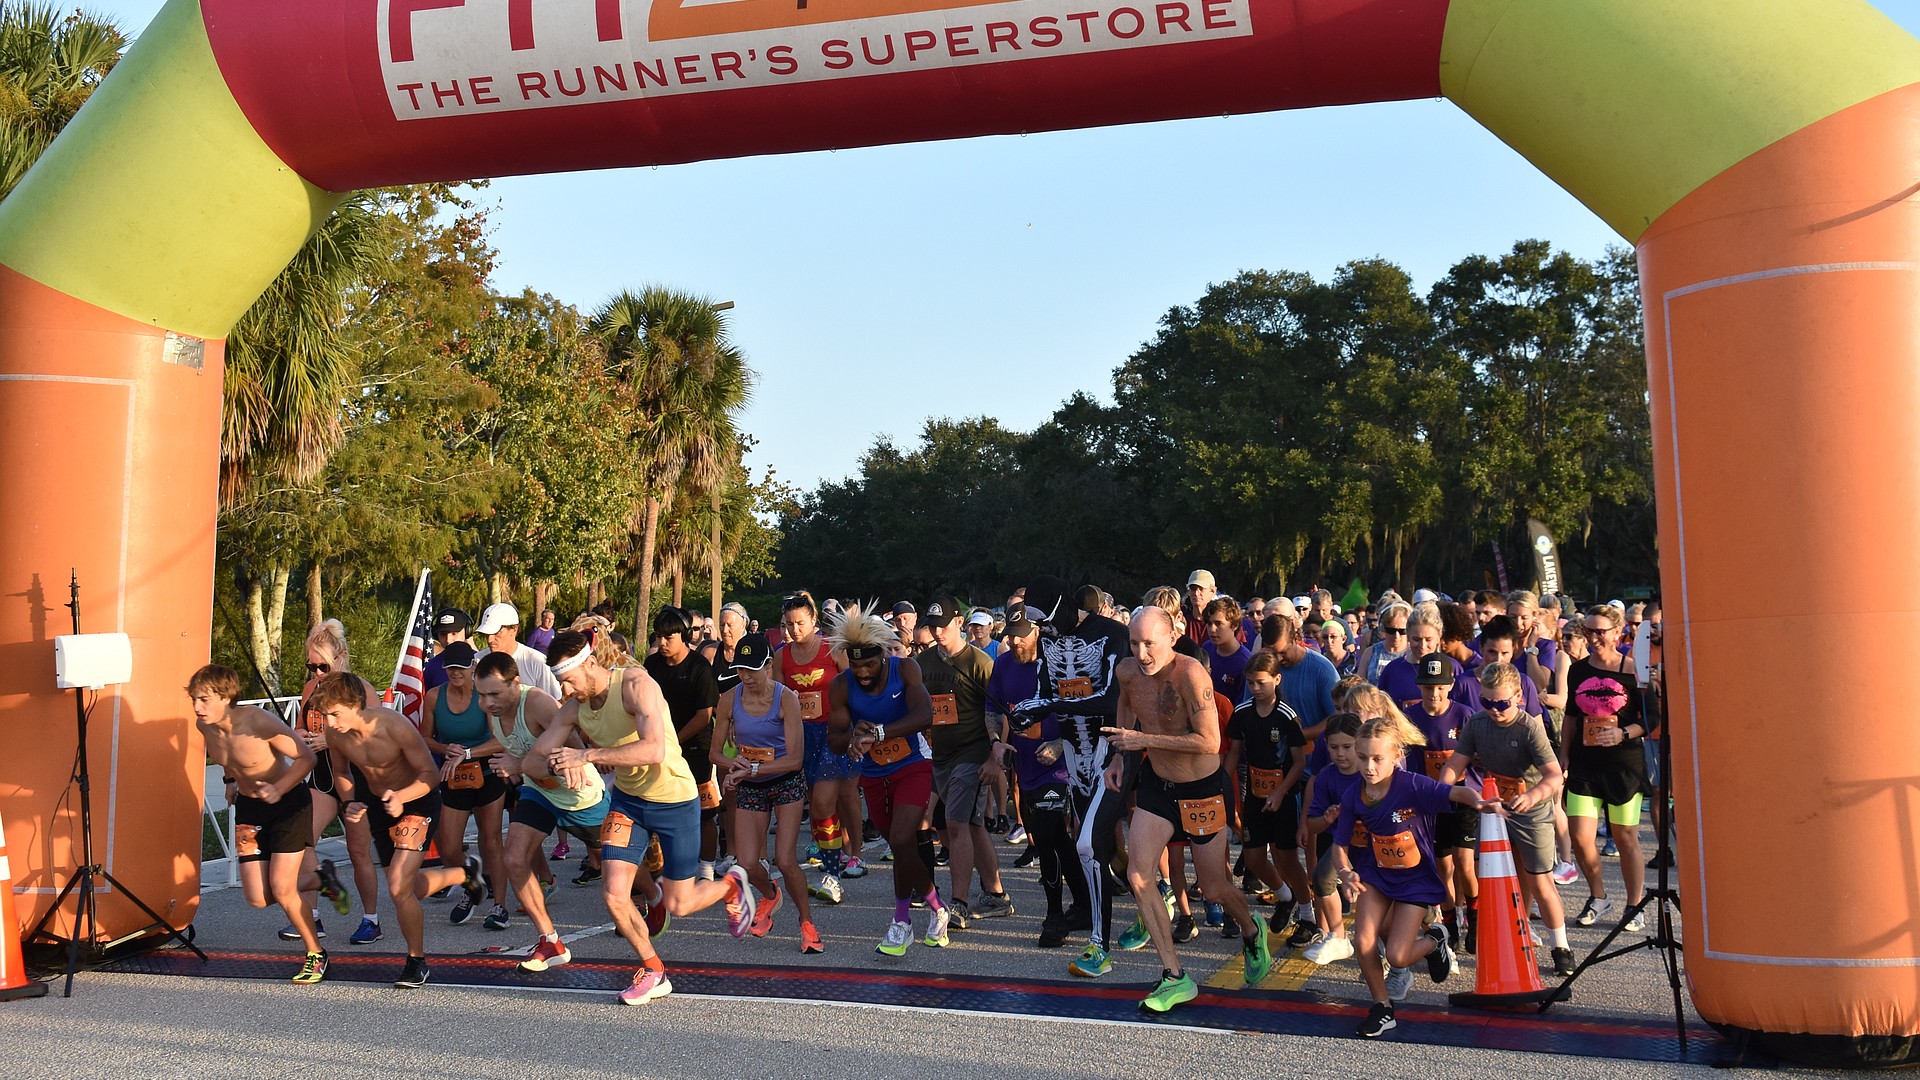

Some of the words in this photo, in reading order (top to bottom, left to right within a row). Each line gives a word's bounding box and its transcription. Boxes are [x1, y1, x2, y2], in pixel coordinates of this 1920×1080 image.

[397, 76, 500, 111] THE
[516, 46, 798, 100] RUNNER'S
[821, 0, 1236, 70] SUPERSTORE
[875, 744, 899, 756] 950
[455, 773, 475, 782] 896
[1255, 779, 1276, 789] 863
[701, 792, 713, 801] 86
[1190, 810, 1216, 823] 952
[1381, 848, 1406, 858] 916
